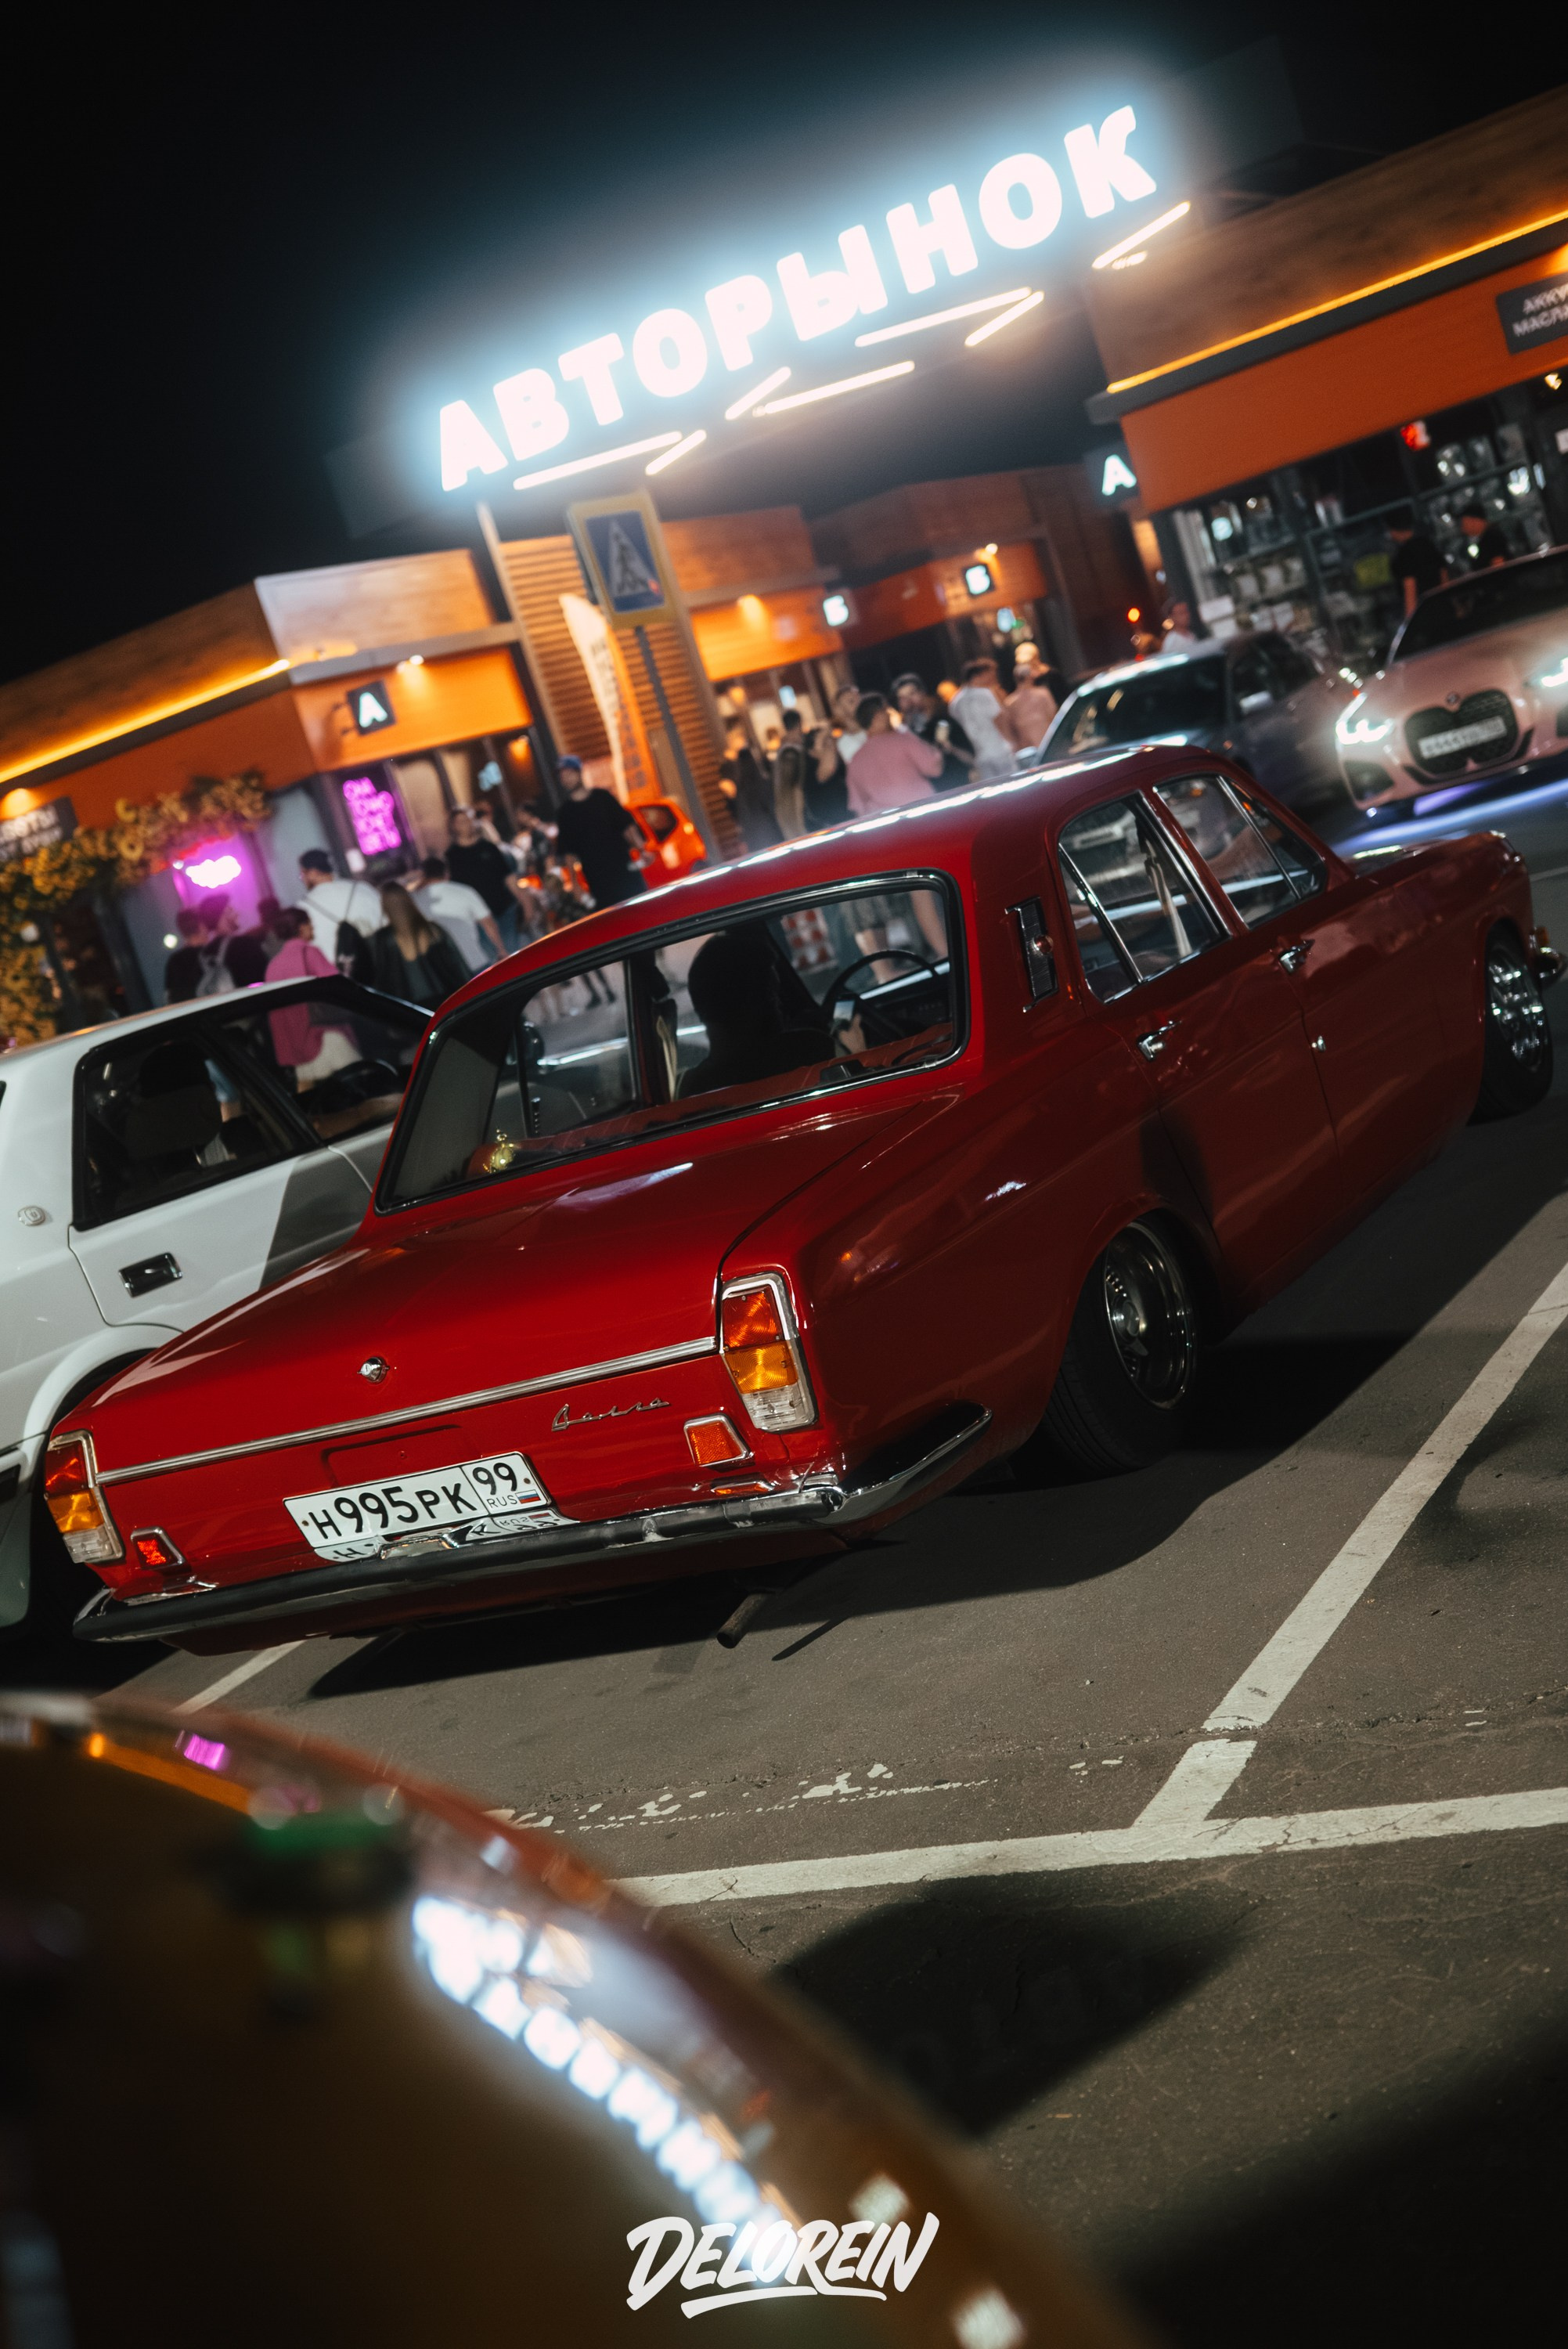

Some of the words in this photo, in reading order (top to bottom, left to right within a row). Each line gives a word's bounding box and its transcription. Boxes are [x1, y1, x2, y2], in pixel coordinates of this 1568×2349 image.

[438, 104, 1157, 492] АВТОРЫНОК
[472, 1463, 517, 1495] 99
[486, 1494, 517, 1509] RUS
